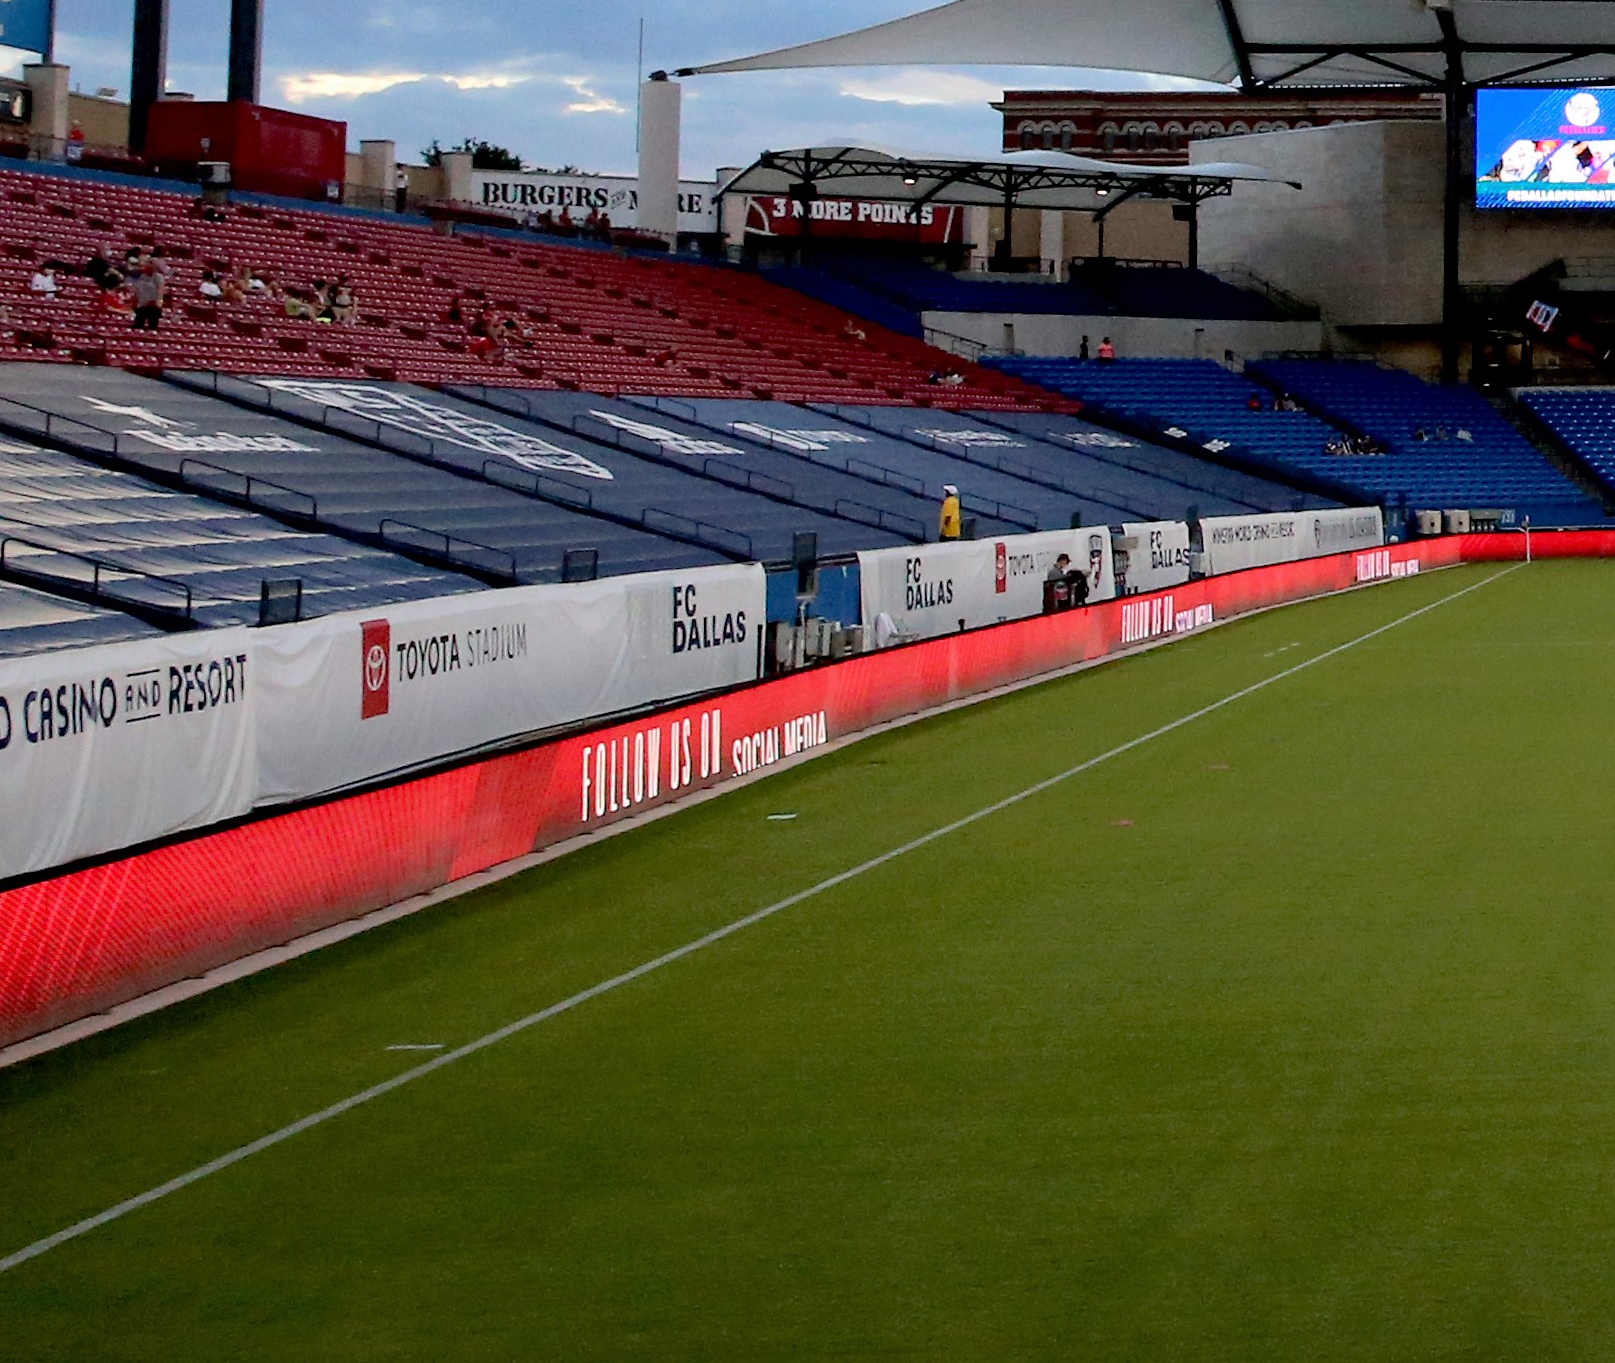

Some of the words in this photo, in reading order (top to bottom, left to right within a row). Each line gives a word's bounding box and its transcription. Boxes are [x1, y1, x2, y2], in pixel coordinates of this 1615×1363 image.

[482, 182, 608, 209] BURGERS
[772, 198, 787, 218] 3
[906, 557, 921, 584] FC
[673, 584, 696, 619] FC
[906, 578, 954, 611] DALLAS
[673, 610, 746, 653] DALLAS
[397, 633, 461, 682] TOYOTA
[467, 623, 527, 667] STADIUM
[24, 677, 117, 743] CASINO
[126, 679, 161, 713] AND
[168, 653, 247, 715] RESORT
[581, 726, 661, 822] FOLLOW
[670, 717, 692, 790] US
[700, 708, 721, 778] ON
